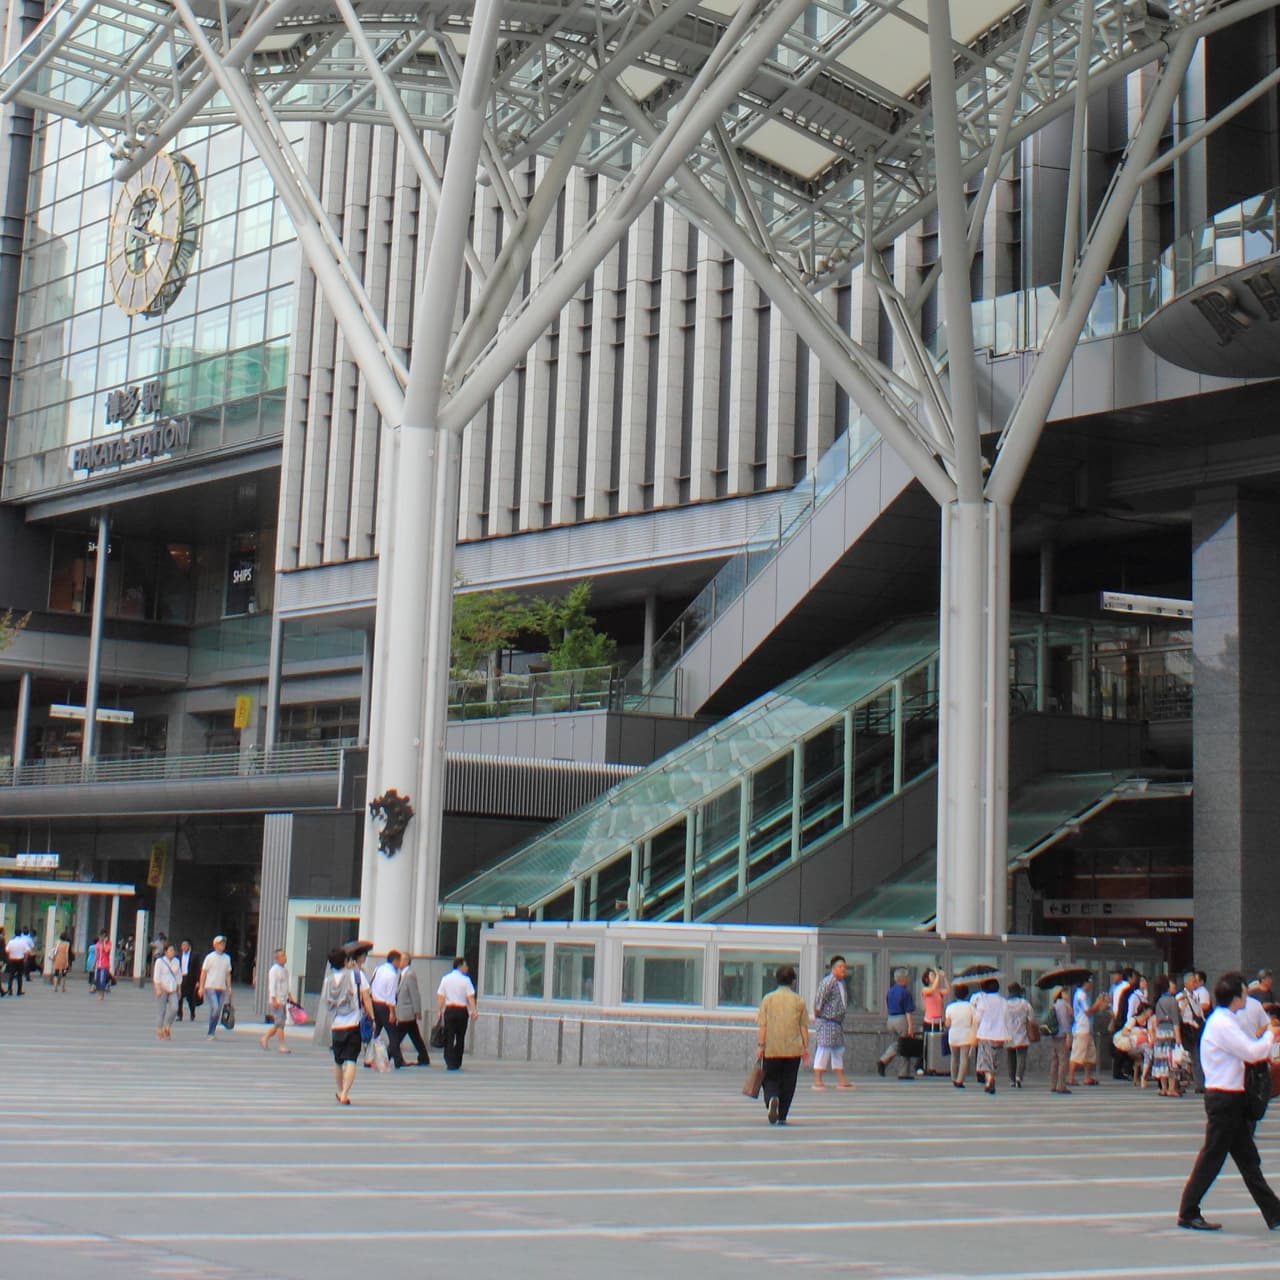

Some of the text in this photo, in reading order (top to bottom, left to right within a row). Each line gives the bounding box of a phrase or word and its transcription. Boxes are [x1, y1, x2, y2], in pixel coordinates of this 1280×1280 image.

[105, 380, 160, 424] 博多駅
[74, 416, 191, 471] HAKATA STATION
[232, 568, 252, 583] SHIPS
